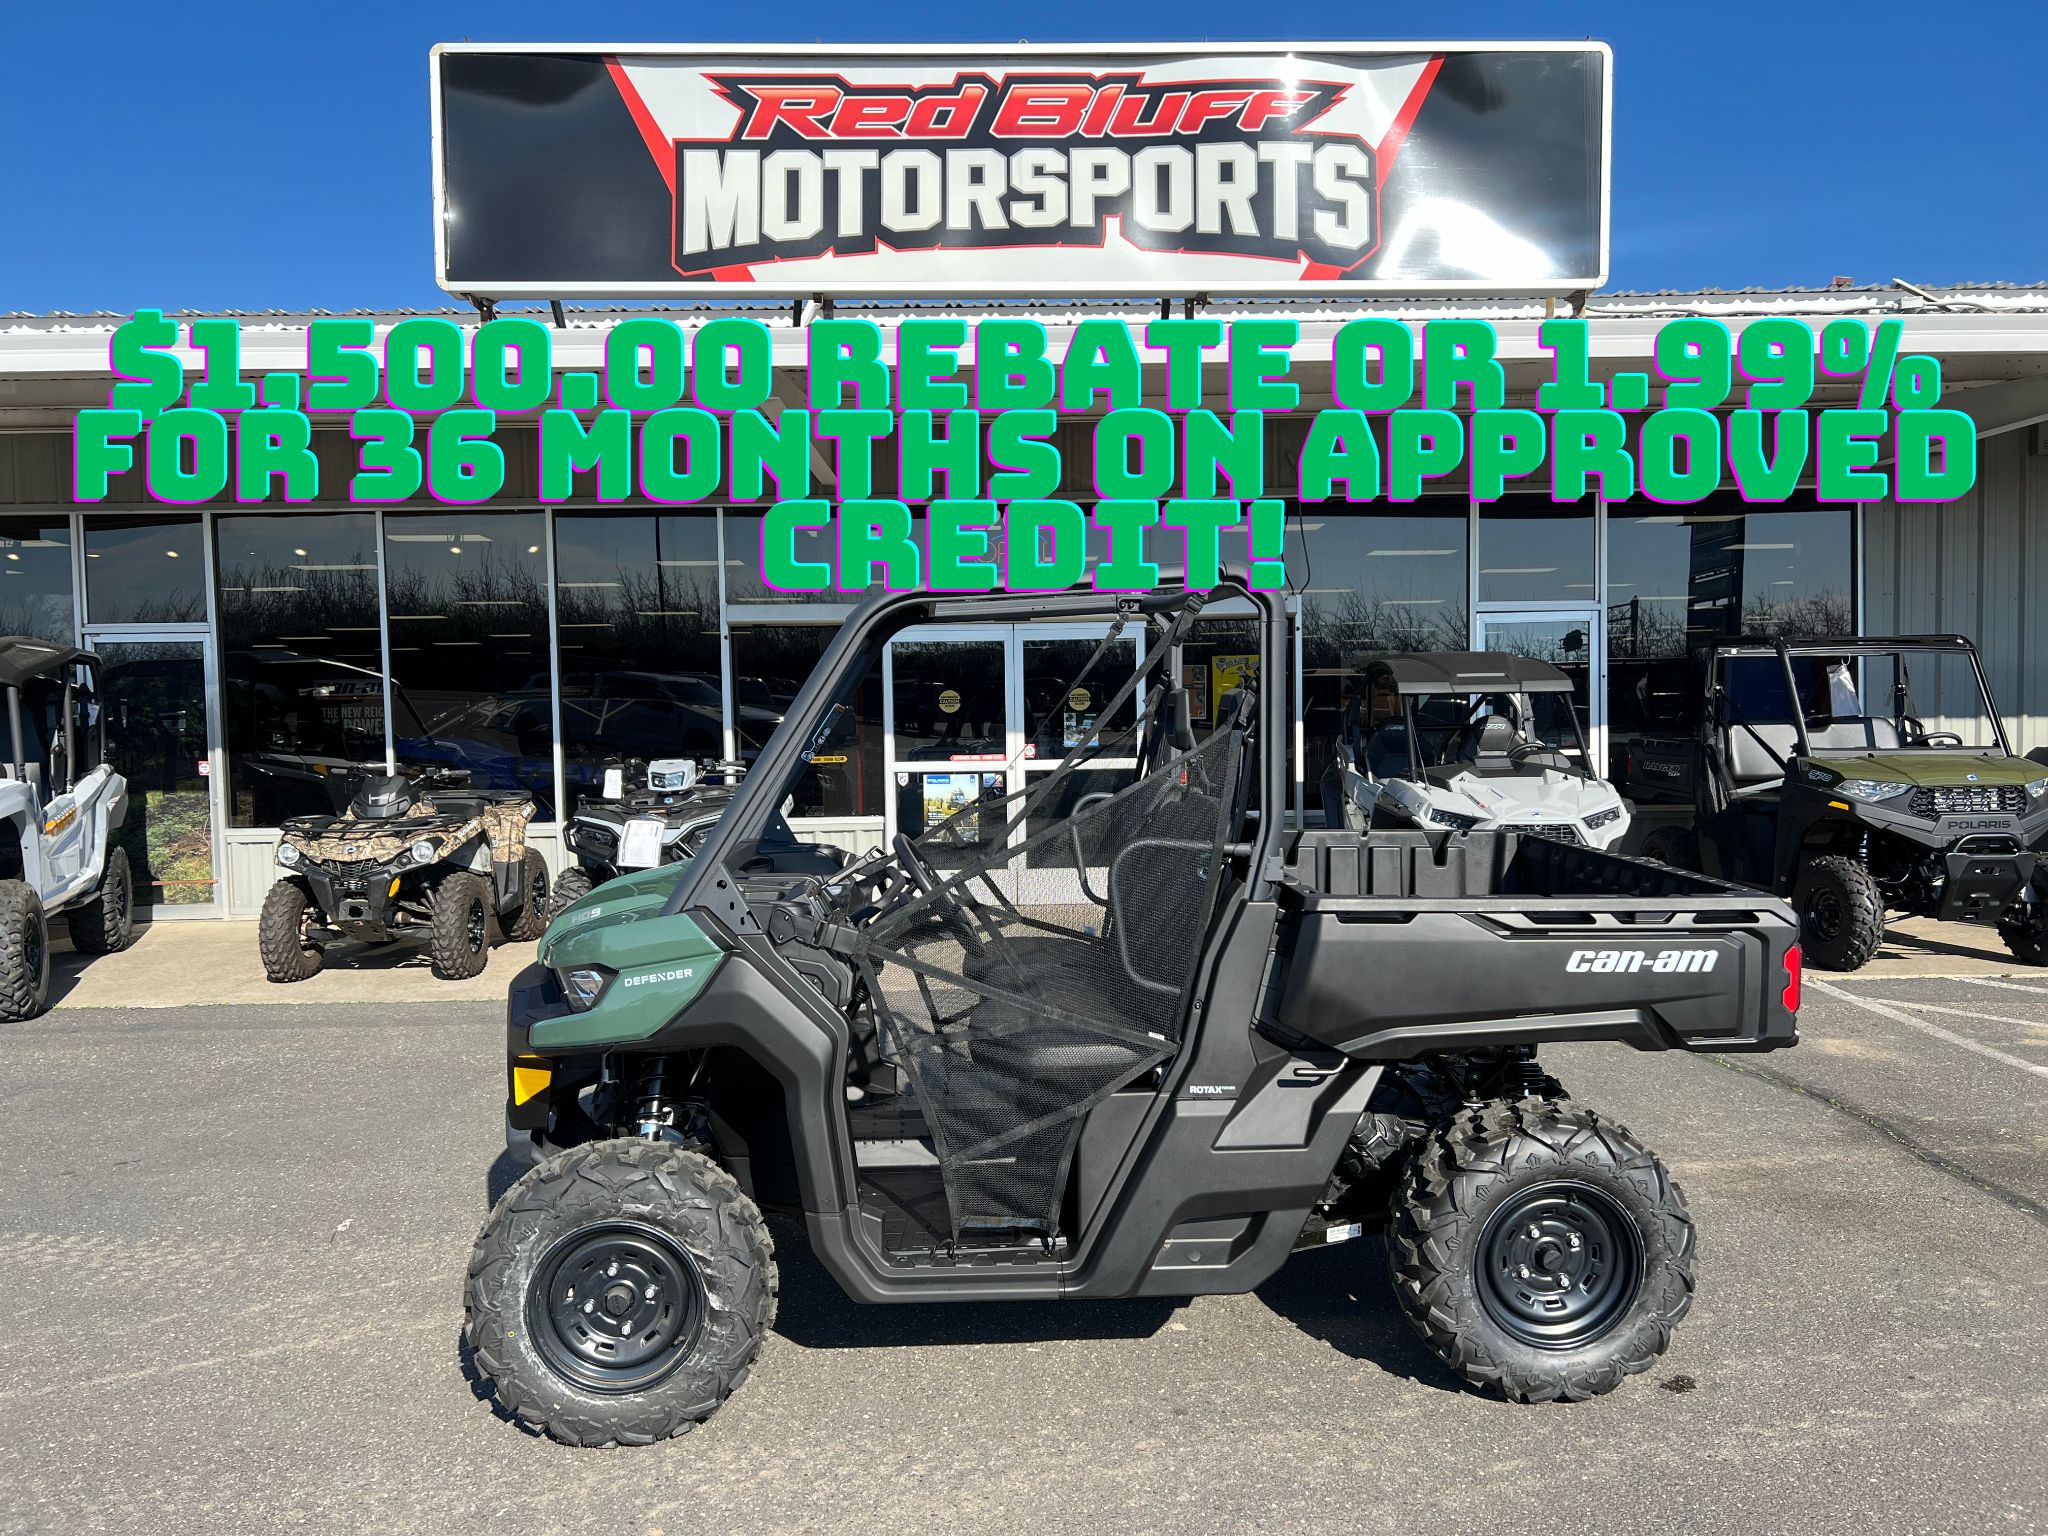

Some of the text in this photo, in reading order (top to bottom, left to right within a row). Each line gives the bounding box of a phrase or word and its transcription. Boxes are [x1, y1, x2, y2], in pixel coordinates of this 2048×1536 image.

[740, 83, 986, 141] Red
[682, 141, 1370, 256] MOTORSPORTS
[321, 707, 384, 718] THE NEW REIG
[343, 719, 385, 735] POWE
[1642, 761, 1681, 773] RANGER
[1947, 820, 2012, 830] POLARIS
[1565, 949, 1719, 973] can-am
[624, 968, 693, 988] DEFENDER
[1189, 1085, 1223, 1094] ROTAX
